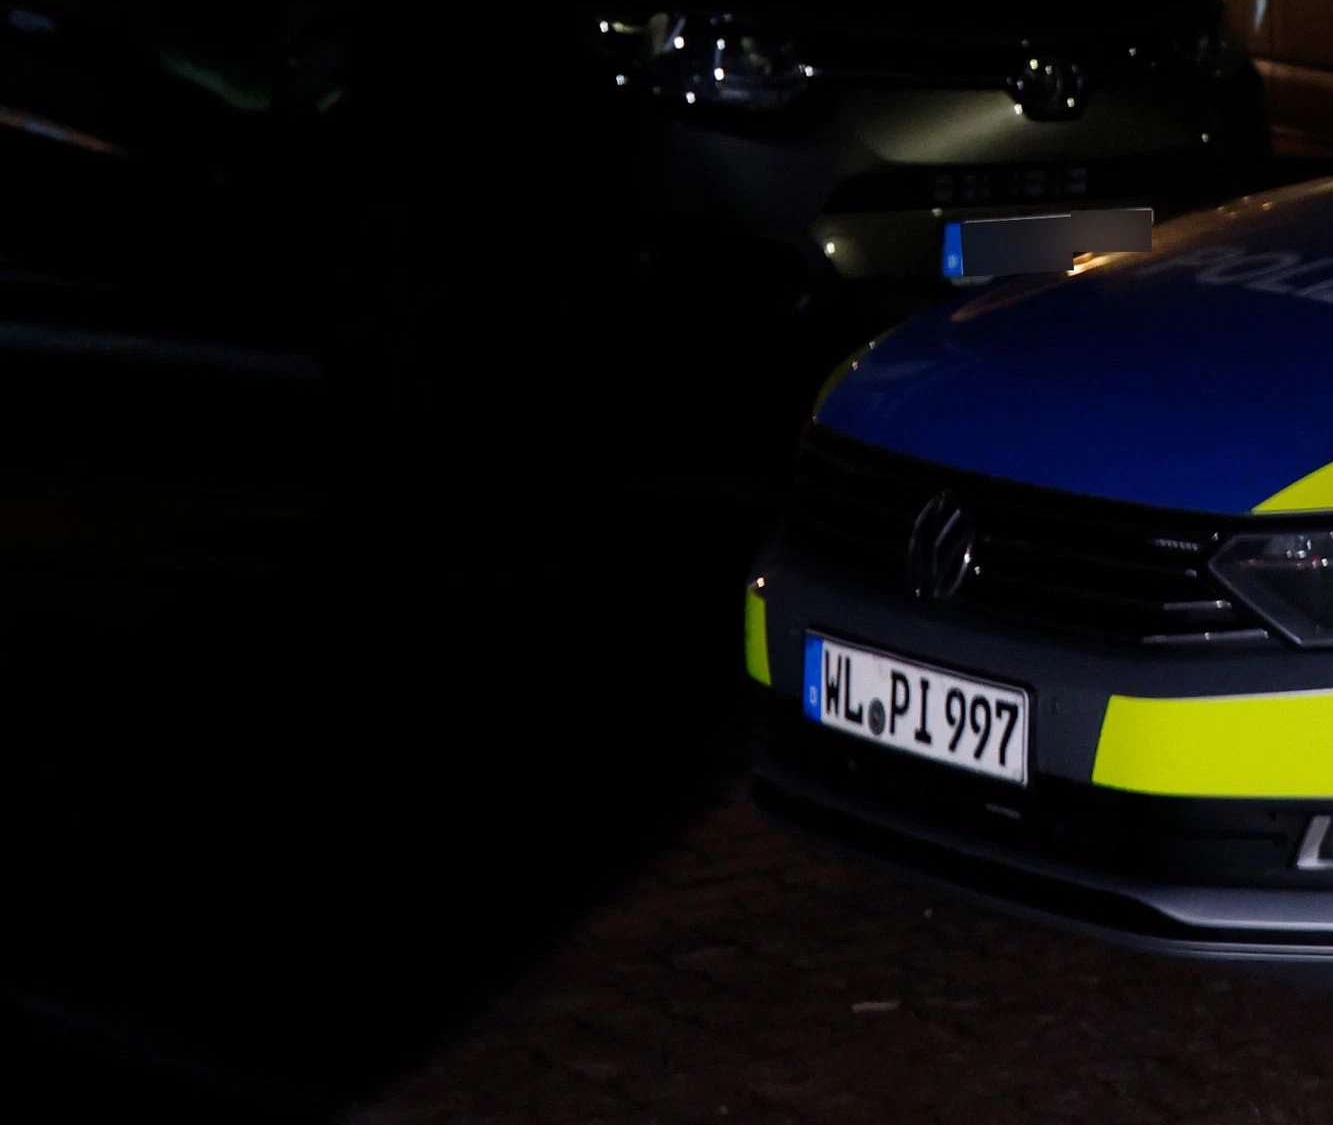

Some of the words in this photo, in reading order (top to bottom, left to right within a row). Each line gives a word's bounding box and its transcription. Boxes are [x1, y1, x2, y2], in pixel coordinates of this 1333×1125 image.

[825, 649, 863, 726] WL
[889, 670, 932, 745] PI
[945, 687, 1019, 766] 997
